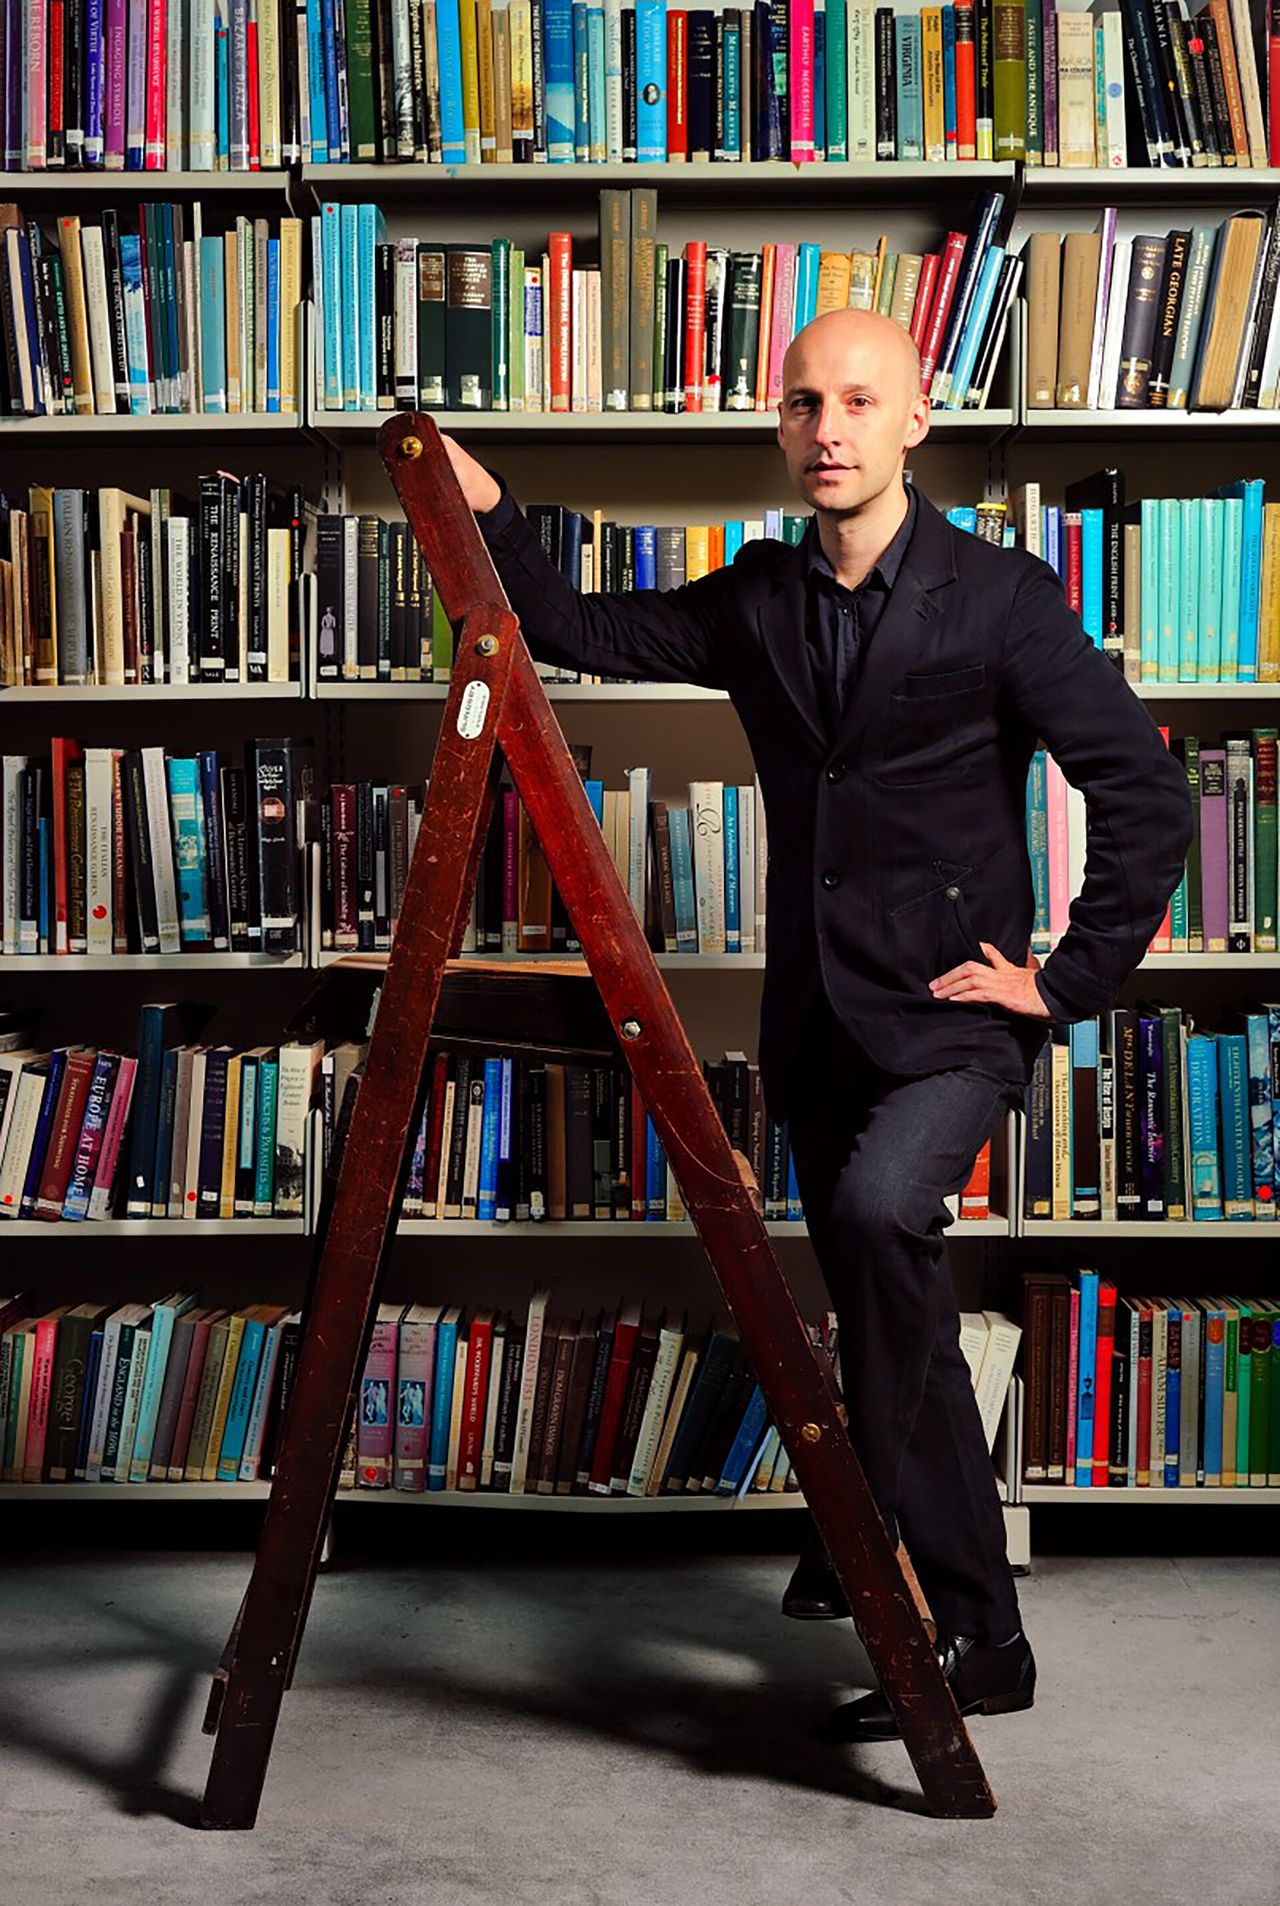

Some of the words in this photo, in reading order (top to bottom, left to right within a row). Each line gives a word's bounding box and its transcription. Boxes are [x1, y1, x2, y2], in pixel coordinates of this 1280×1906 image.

[1172, 238, 1185, 268] LATE
[1163, 272, 1181, 337] GEORGIAN
[210, 505, 218, 525] THE
[210, 532, 218, 601] RENAISSANCE
[210, 609, 218, 639] PRINT
[84, 1076, 106, 1130] EUROPE
[1191, 1061, 1203, 1144] DECORATION
[83, 1133, 94, 1152] AT
[74, 1154, 90, 1196] HOME
[526, 1316, 541, 1373] LONDON
[56, 1359, 83, 1421] George
[114, 1358, 130, 1406] ENGLAND
